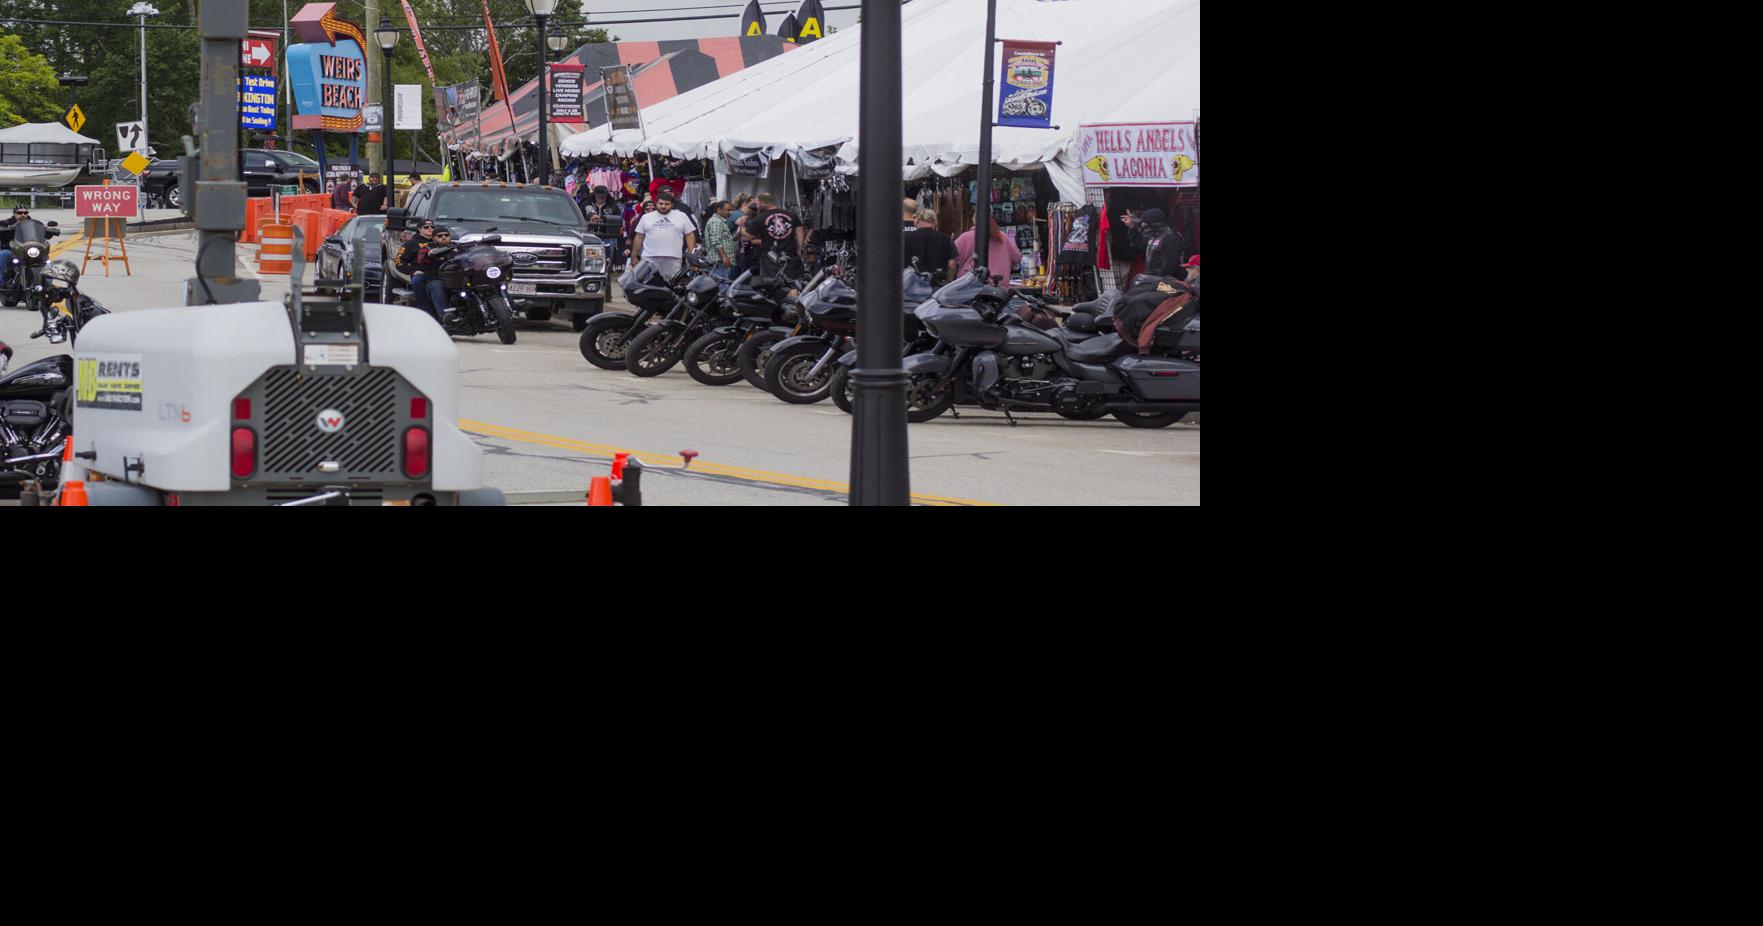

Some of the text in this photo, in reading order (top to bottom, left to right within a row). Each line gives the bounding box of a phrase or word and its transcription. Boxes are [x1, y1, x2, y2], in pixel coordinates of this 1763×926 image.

[800, 17, 821, 38] A
[320, 55, 362, 81] WEIRS
[244, 77, 258, 86] Test
[259, 78, 275, 88] Drive
[242, 92, 275, 105] NINGTON
[321, 84, 362, 110] BEACH
[1095, 130, 1132, 154] HELLS
[1136, 127, 1185, 153] ANGELS
[1114, 157, 1168, 179] LACONIA
[83, 190, 131, 200] WRONG
[92, 202, 121, 213] WAY
[98, 361, 141, 378] RENTS
